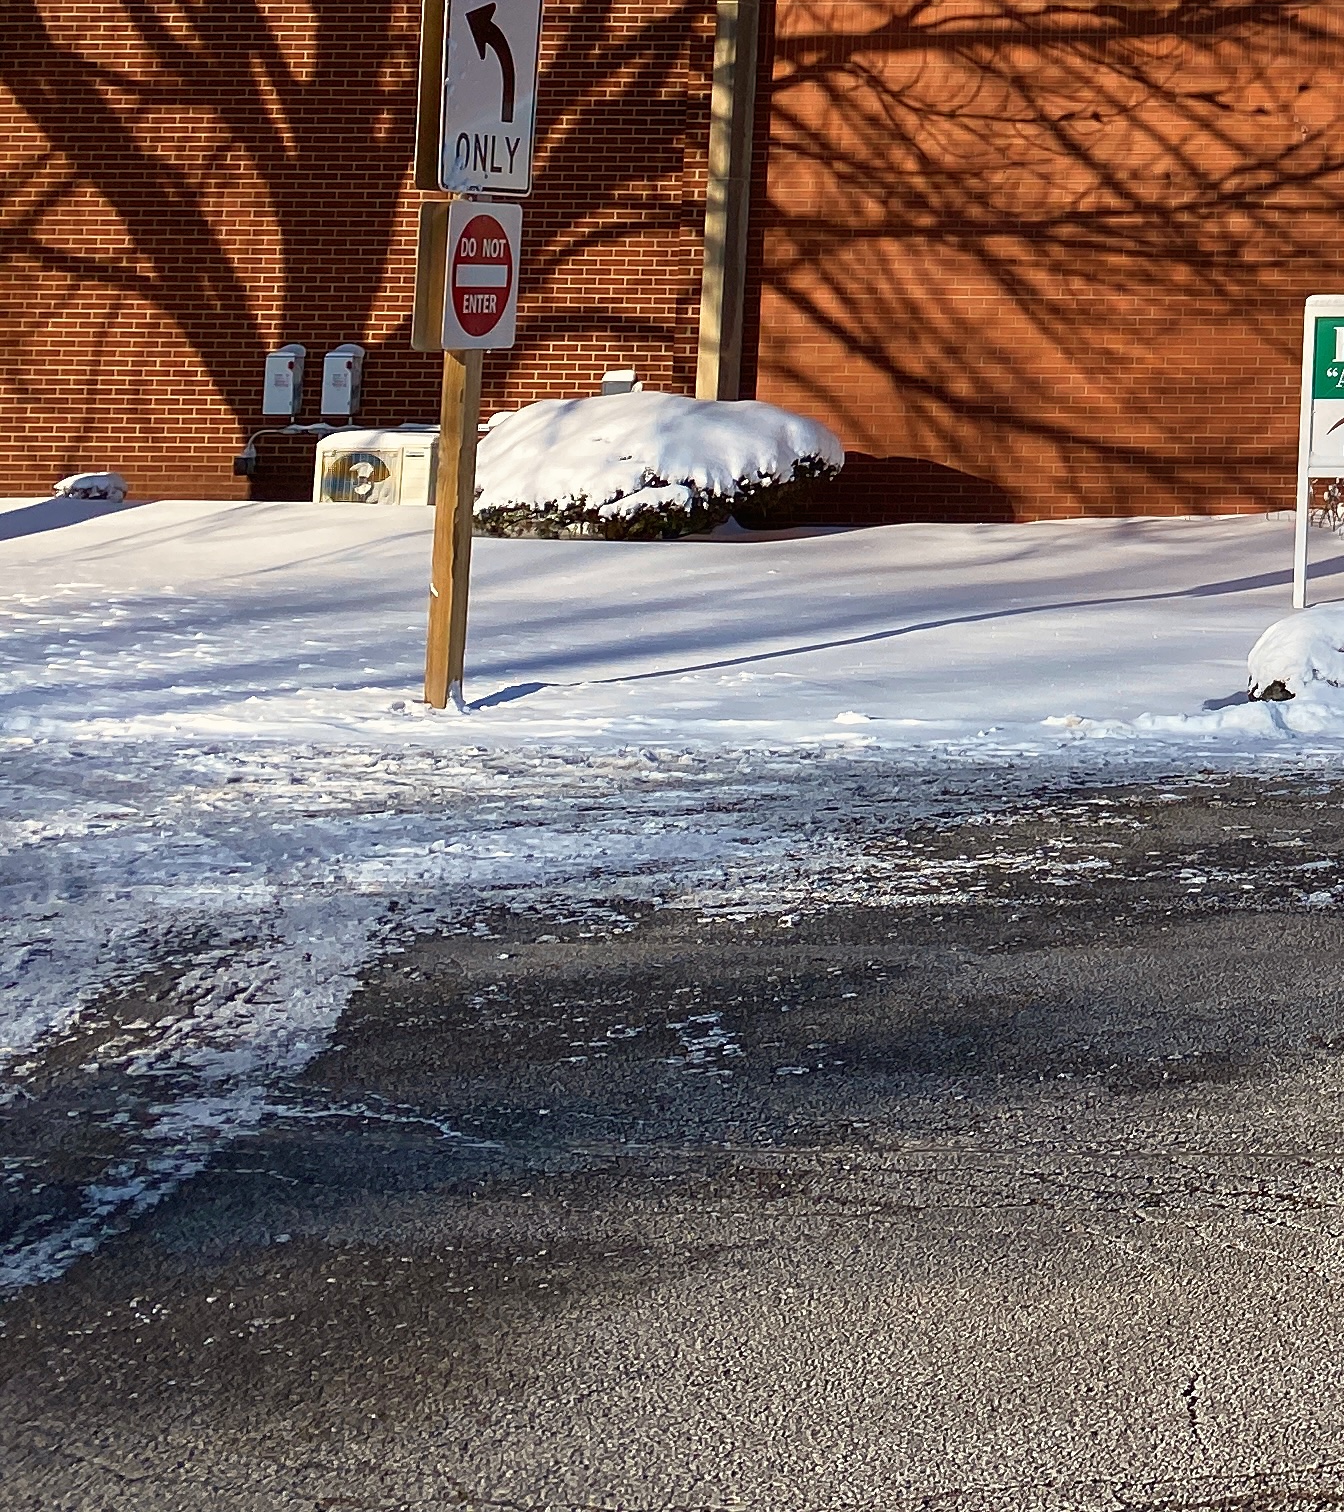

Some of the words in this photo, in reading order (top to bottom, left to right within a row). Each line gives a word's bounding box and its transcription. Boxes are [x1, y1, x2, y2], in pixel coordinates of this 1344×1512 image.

[456, 132, 521, 174] ONLY
[460, 237, 477, 257] DO
[482, 238, 507, 258] NOT
[462, 294, 497, 314] ENTER
